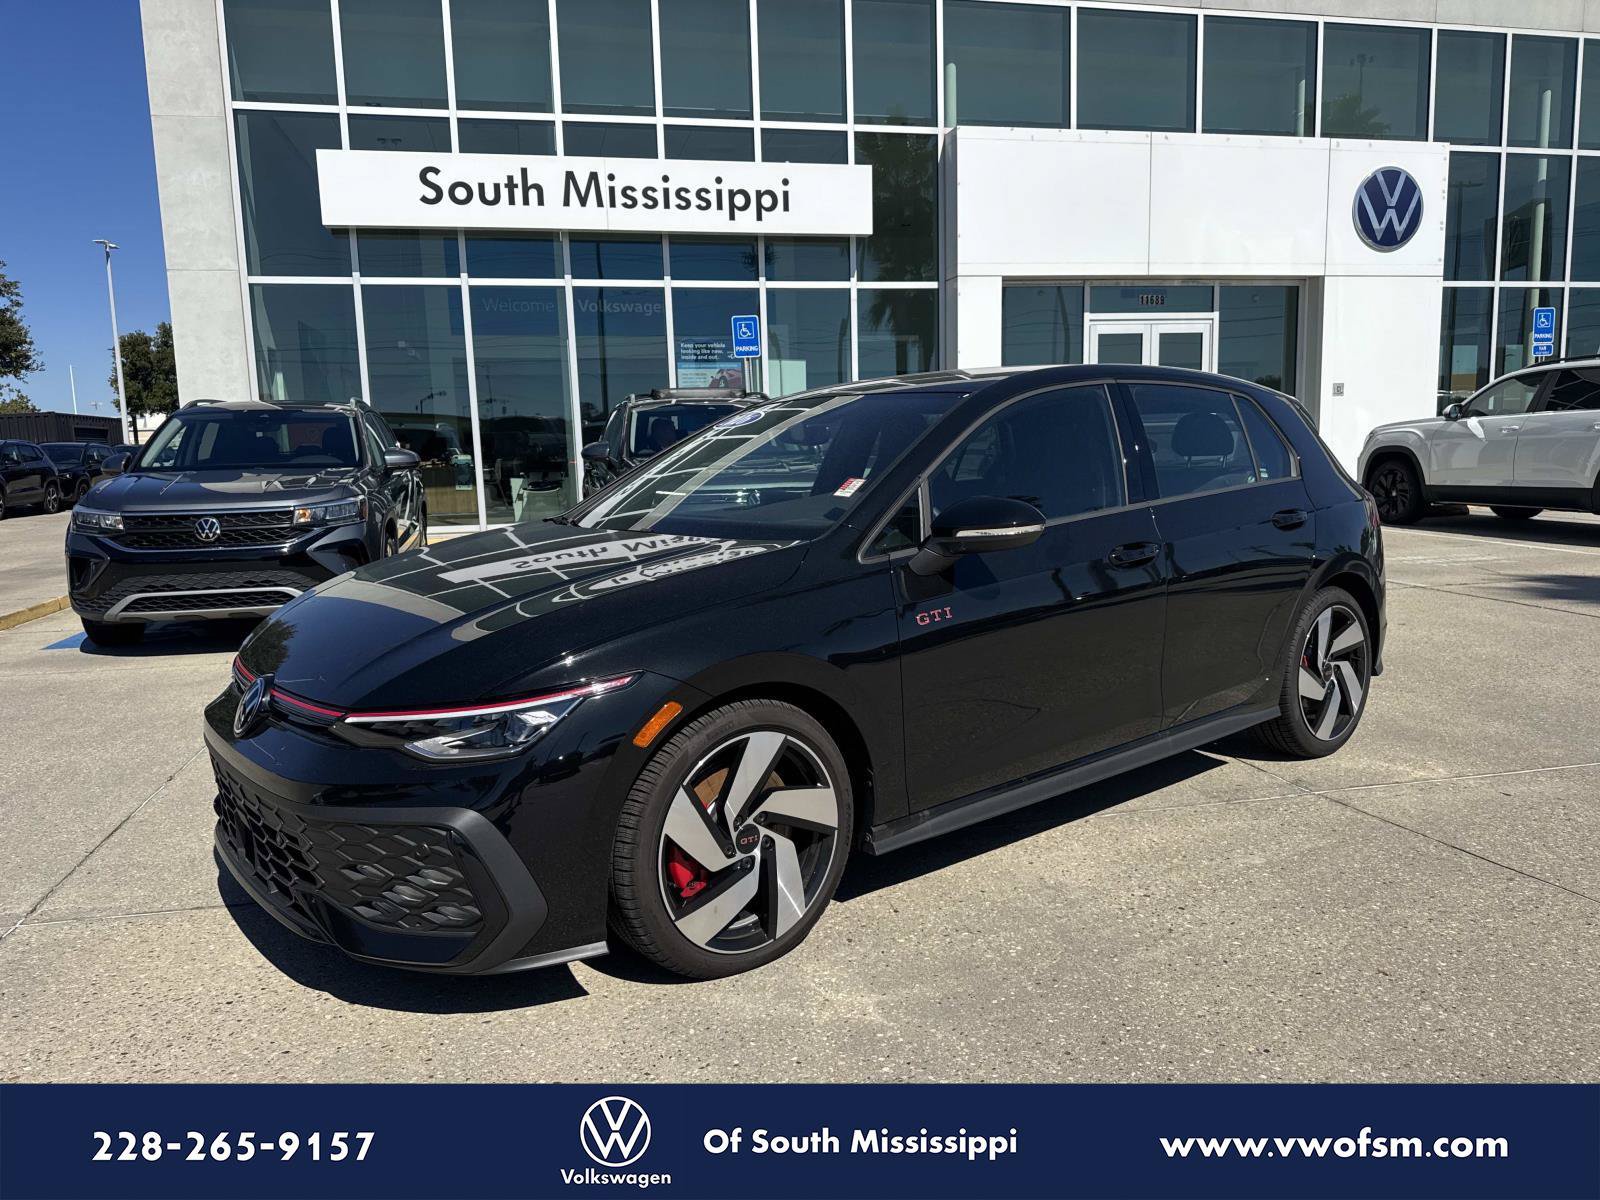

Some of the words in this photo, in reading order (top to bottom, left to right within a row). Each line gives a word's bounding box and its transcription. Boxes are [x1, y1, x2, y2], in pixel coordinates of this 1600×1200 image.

[419, 166, 544, 207] South
[563, 171, 791, 221] Mississippi
[1357, 168, 1422, 244] VW
[481, 297, 555, 313] Welcome
[577, 299, 661, 316] Volkswage
[916, 606, 952, 626] GTI
[740, 834, 759, 845] GTI
